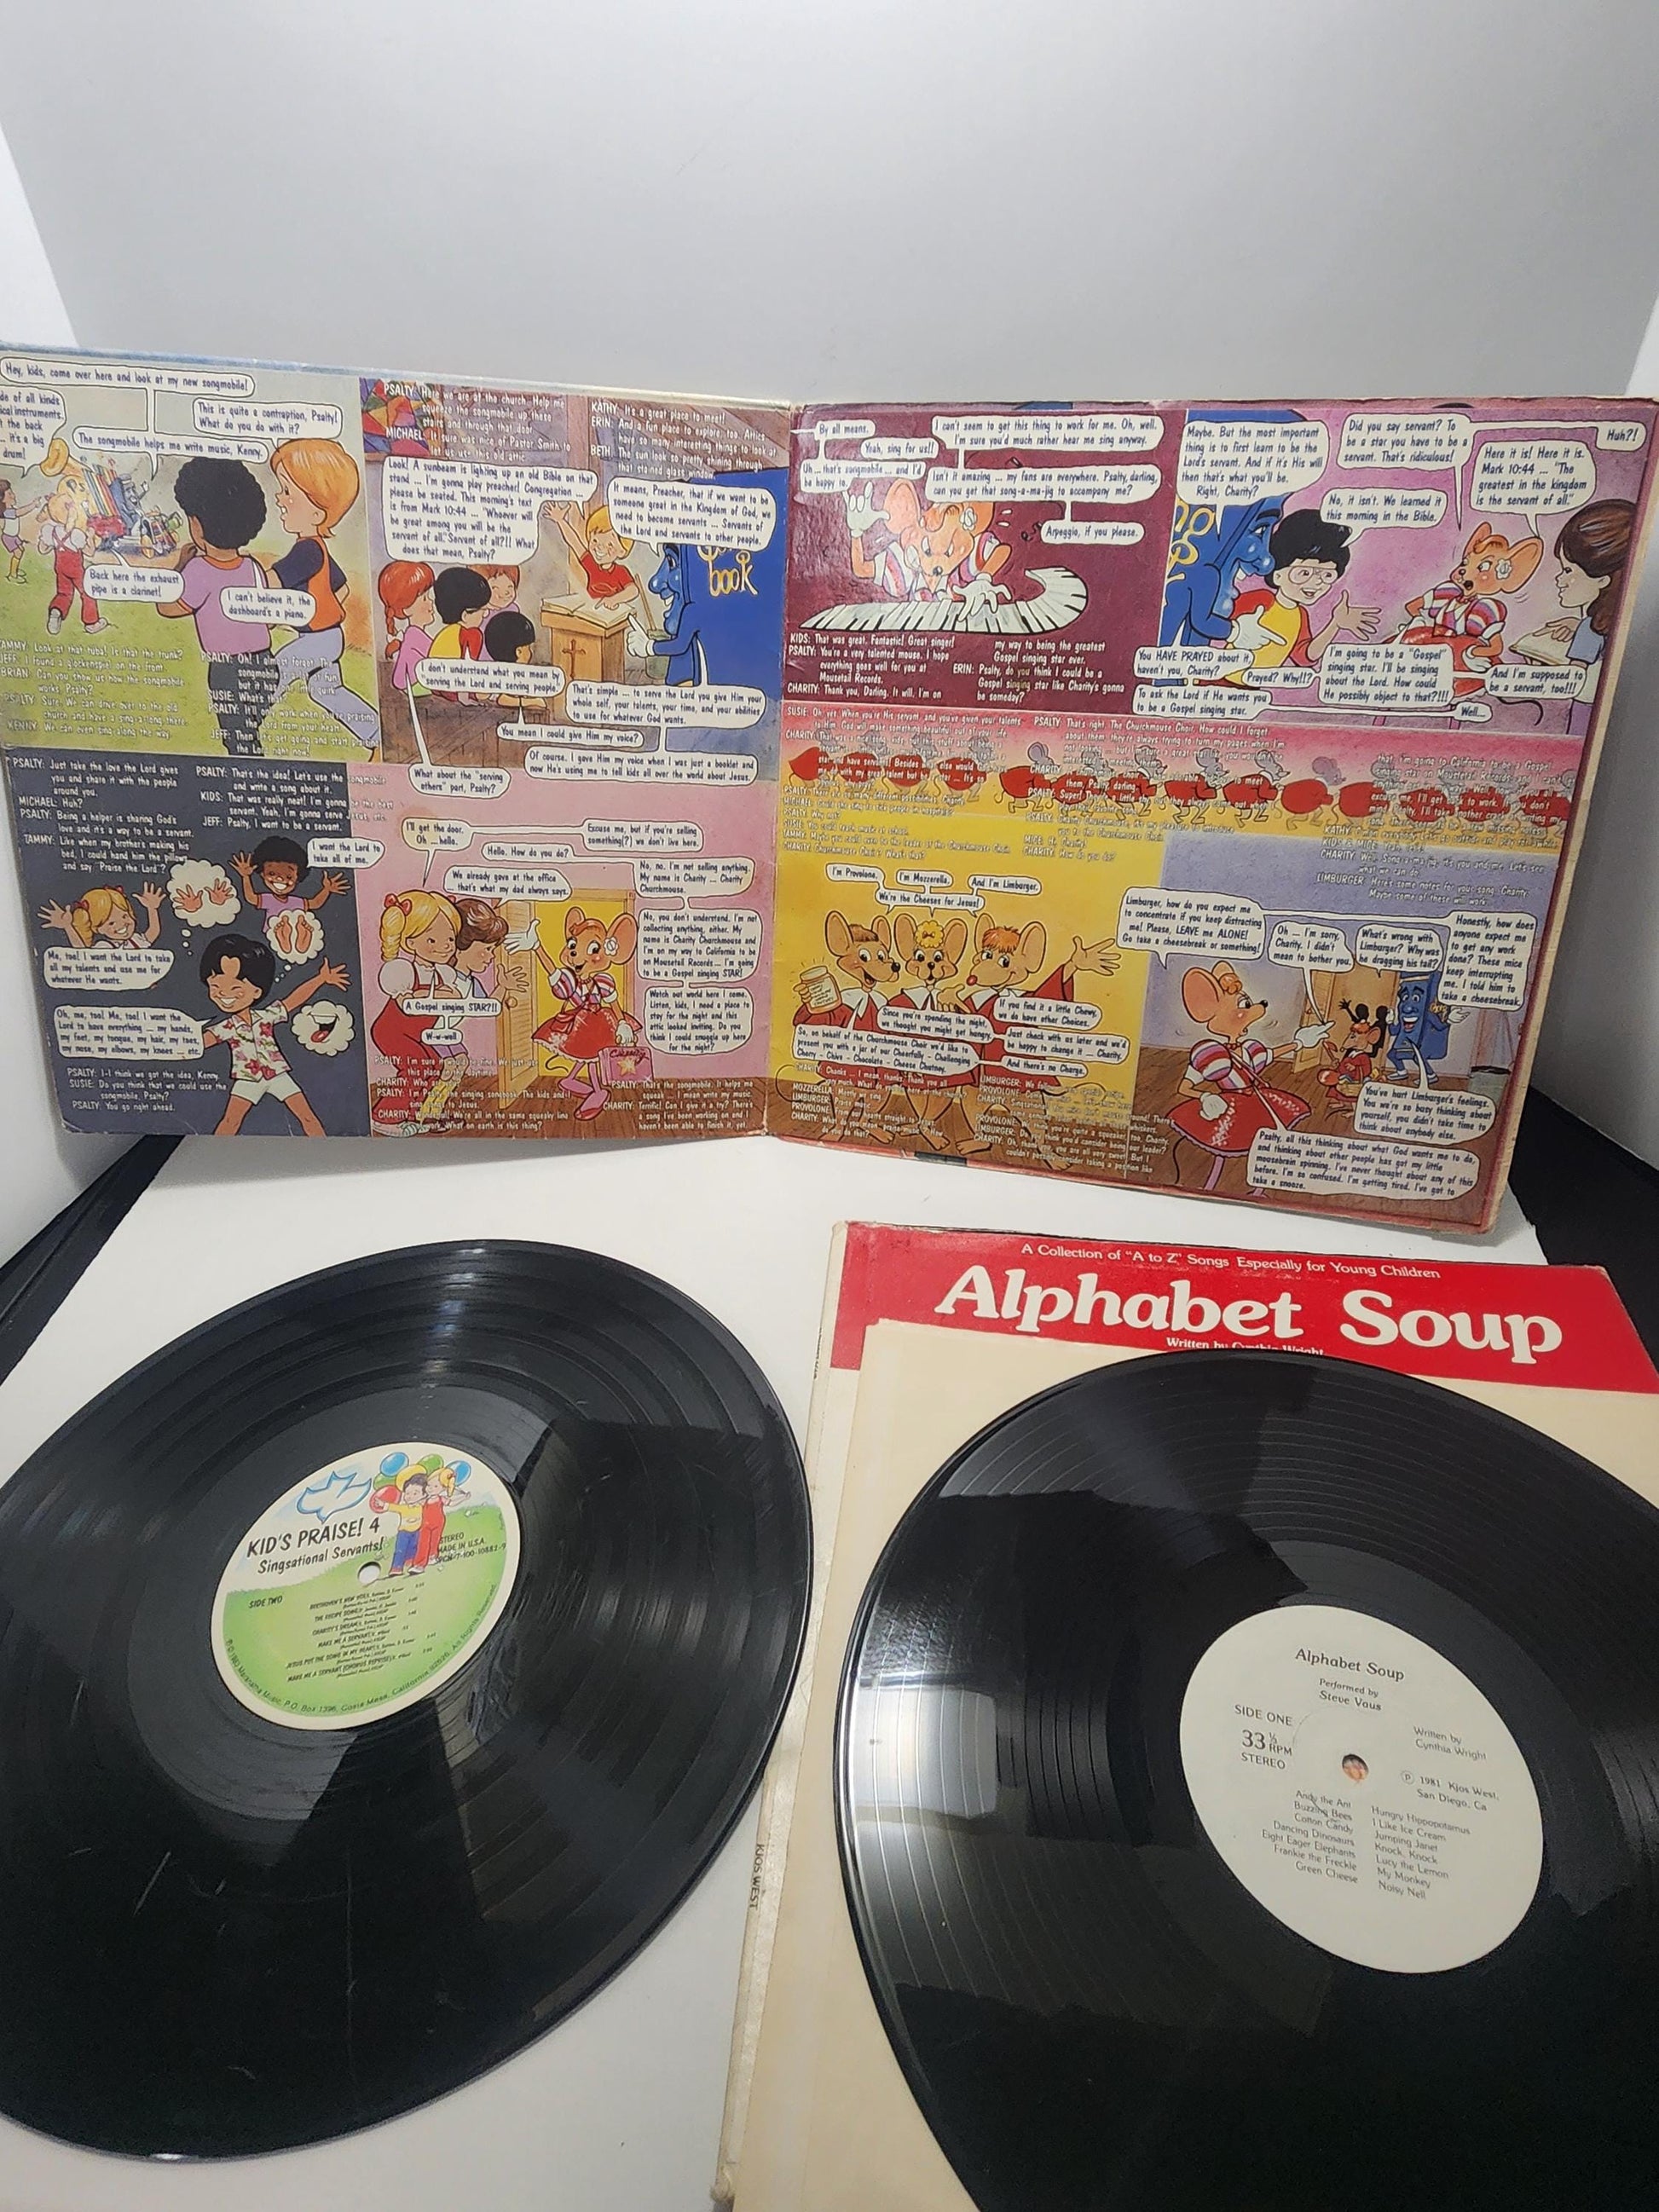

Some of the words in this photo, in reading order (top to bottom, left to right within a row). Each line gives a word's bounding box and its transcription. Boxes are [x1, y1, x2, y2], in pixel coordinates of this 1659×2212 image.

[5, 361, 23, 378] Hey,
[49, 369, 70, 378] come
[74, 371, 91, 379] over
[94, 368, 113, 381] here
[116, 371, 130, 382] and
[134, 371, 151, 383] look
[154, 374, 163, 384] at
[167, 377, 178, 388] my
[182, 378, 198, 386] new
[201, 378, 247, 391] songmobile!
[198, 401, 214, 413] This
[218, 405, 225, 414] is
[228, 405, 249, 418] quite
[252, 408, 257, 417] a
[311, 409, 337, 424] Psalty!
[820, 423, 829, 436] By
[831, 423, 841, 434] all
[1606, 427, 1639, 442] Huh?!
[1328, 493, 1343, 506] No,
[1347, 495, 1355, 505] it
[1383, 494, 1396, 505] We
[1400, 494, 1431, 506] learned
[1434, 496, 1442, 506] it
[1045, 524, 1080, 540] Arpeggio,
[1084, 525, 1091, 536] if
[1094, 528, 1107, 539] you
[1111, 525, 1137, 540] please.
[709, 549, 758, 598] book
[789, 632, 810, 644] KIDS:
[814, 632, 829, 644] That
[832, 636, 845, 644] was
[870, 633, 905, 646] Fantastic!
[907, 633, 928, 646] Great
[930, 635, 955, 649] singer!
[1246, 671, 1279, 684] Prayed?
[500, 725, 513, 736] You
[540, 727, 543, 737] I
[546, 728, 565, 738] could
[568, 730, 582, 742] give
[586, 729, 599, 740] Him
[603, 734, 613, 743] my
[616, 732, 639, 743] voice?
[61, 797, 83, 808] Huh?
[511, 846, 525, 856] How
[529, 847, 537, 857] do
[540, 850, 552, 858] you
[555, 847, 569, 858] do?
[832, 866, 842, 875] I'm
[900, 871, 910, 881] I'm
[973, 876, 985, 887] And
[988, 877, 999, 887] I'm
[880, 891, 896, 901] We're
[899, 892, 910, 902] the
[913, 892, 941, 904] Cheeses
[944, 896, 954, 905] for
[956, 896, 979, 908] Jesus!
[407, 1001, 412, 1010] A
[414, 1001, 438, 1013] Gospel
[441, 1002, 465, 1014] singing
[1365, 1085, 1388, 1097] You've
[1391, 1089, 1408, 1099] hurt
[1410, 1090, 1454, 1105] Limburger's
[1457, 1094, 1488, 1109] feelings.
[1020, 1243, 1033, 1254] A
[1037, 1244, 1102, 1259] Collection
[1107, 1249, 1121, 1260] of
[1147, 1252, 1162, 1262] to
[1187, 1253, 1229, 1268] Songs
[1236, 1256, 1302, 1273] Especially
[1305, 1260, 1325, 1272] for
[1329, 1261, 1377, 1277] Young
[1380, 1264, 1440, 1278] Children
[934, 1265, 1304, 1338] Alphabet
[1340, 1289, 1562, 1364] Soup
[1166, 1337, 1210, 1349] Written
[246, 1533, 292, 1557] KID'S
[298, 1517, 364, 1548] PRAISE!
[369, 1517, 380, 1533] 4
[439, 1532, 465, 1544] STEREO
[257, 1549, 328, 1574] Singsational
[332, 1536, 384, 1559] Servants!
[438, 1544, 456, 1553] MADE
[248, 1598, 266, 1608] SIDE
[269, 1596, 283, 1605] TWO
[1295, 1648, 1361, 1672] Alphabet
[1367, 1661, 1405, 1682] Soup
[1319, 1678, 1365, 1695] Performed
[1368, 1688, 1379, 1698] by
[1319, 1689, 1350, 1705] Steve
[1354, 1696, 1382, 1711] Vaus
[1234, 1704, 1263, 1719] SIDE
[1267, 1711, 1292, 1727] ONE
[1241, 1729, 1266, 1750] 33
[1413, 1725, 1447, 1741] Written
[1449, 1733, 1462, 1745] by
[1269, 1743, 1292, 1756] RPM
[1415, 1738, 1452, 1754] Cynthia
[1454, 1747, 1487, 1761] Wright
[1241, 1752, 1286, 1770] STEREO
[1419, 1776, 1441, 1788] 1981
[1448, 1781, 1470, 1793] Kjos
[1295, 1790, 1318, 1802] Andy
[1320, 1795, 1333, 1805] the
[1336, 1798, 1351, 1808] Ant
[1417, 1788, 1436, 1800] San
[1474, 1800, 1487, 1811] Ca
[1294, 1812, 1322, 1827] Cotton
[1326, 1819, 1353, 1834] Candy
[1332, 1808, 1352, 1821] Bees
[1371, 1805, 1404, 1822] Hungry
[1273, 1820, 1309, 1839] Dancing
[1311, 1828, 1355, 1846] Dinosaurs
[1372, 1817, 1376, 1827] I
[1379, 1819, 1397, 1831] Like
[1401, 1824, 1413, 1835] Ice
[1416, 1828, 1447, 1842] Cream
[1262, 1828, 1284, 1842] Eight
[1286, 1834, 1310, 1848] Eager
[1314, 1841, 1356, 1858] Elephants
[1374, 1830, 1413, 1849] Jumping
[1414, 1840, 1438, 1852] Janet
[753, 1843, 765, 1873] KJOS
[1274, 1844, 1305, 1859] Frankie
[1309, 1853, 1322, 1863] the
[1325, 1855, 1357, 1871] Freckle
[1376, 1854, 1397, 1869] Lucy
[1400, 1861, 1414, 1872] the
[1417, 1863, 1449, 1880] Lemon
[1408, 1851, 1438, 1865] Knock
[1295, 1860, 1322, 1875] Green
[1326, 1868, 1358, 1884] Cheese
[1377, 1867, 1391, 1880] My
[1394, 1870, 1431, 1889] Monkey
[749, 1876, 761, 1910] WEST
[1378, 1880, 1404, 1896] Noisy
[1407, 1886, 1426, 1900] Nell
